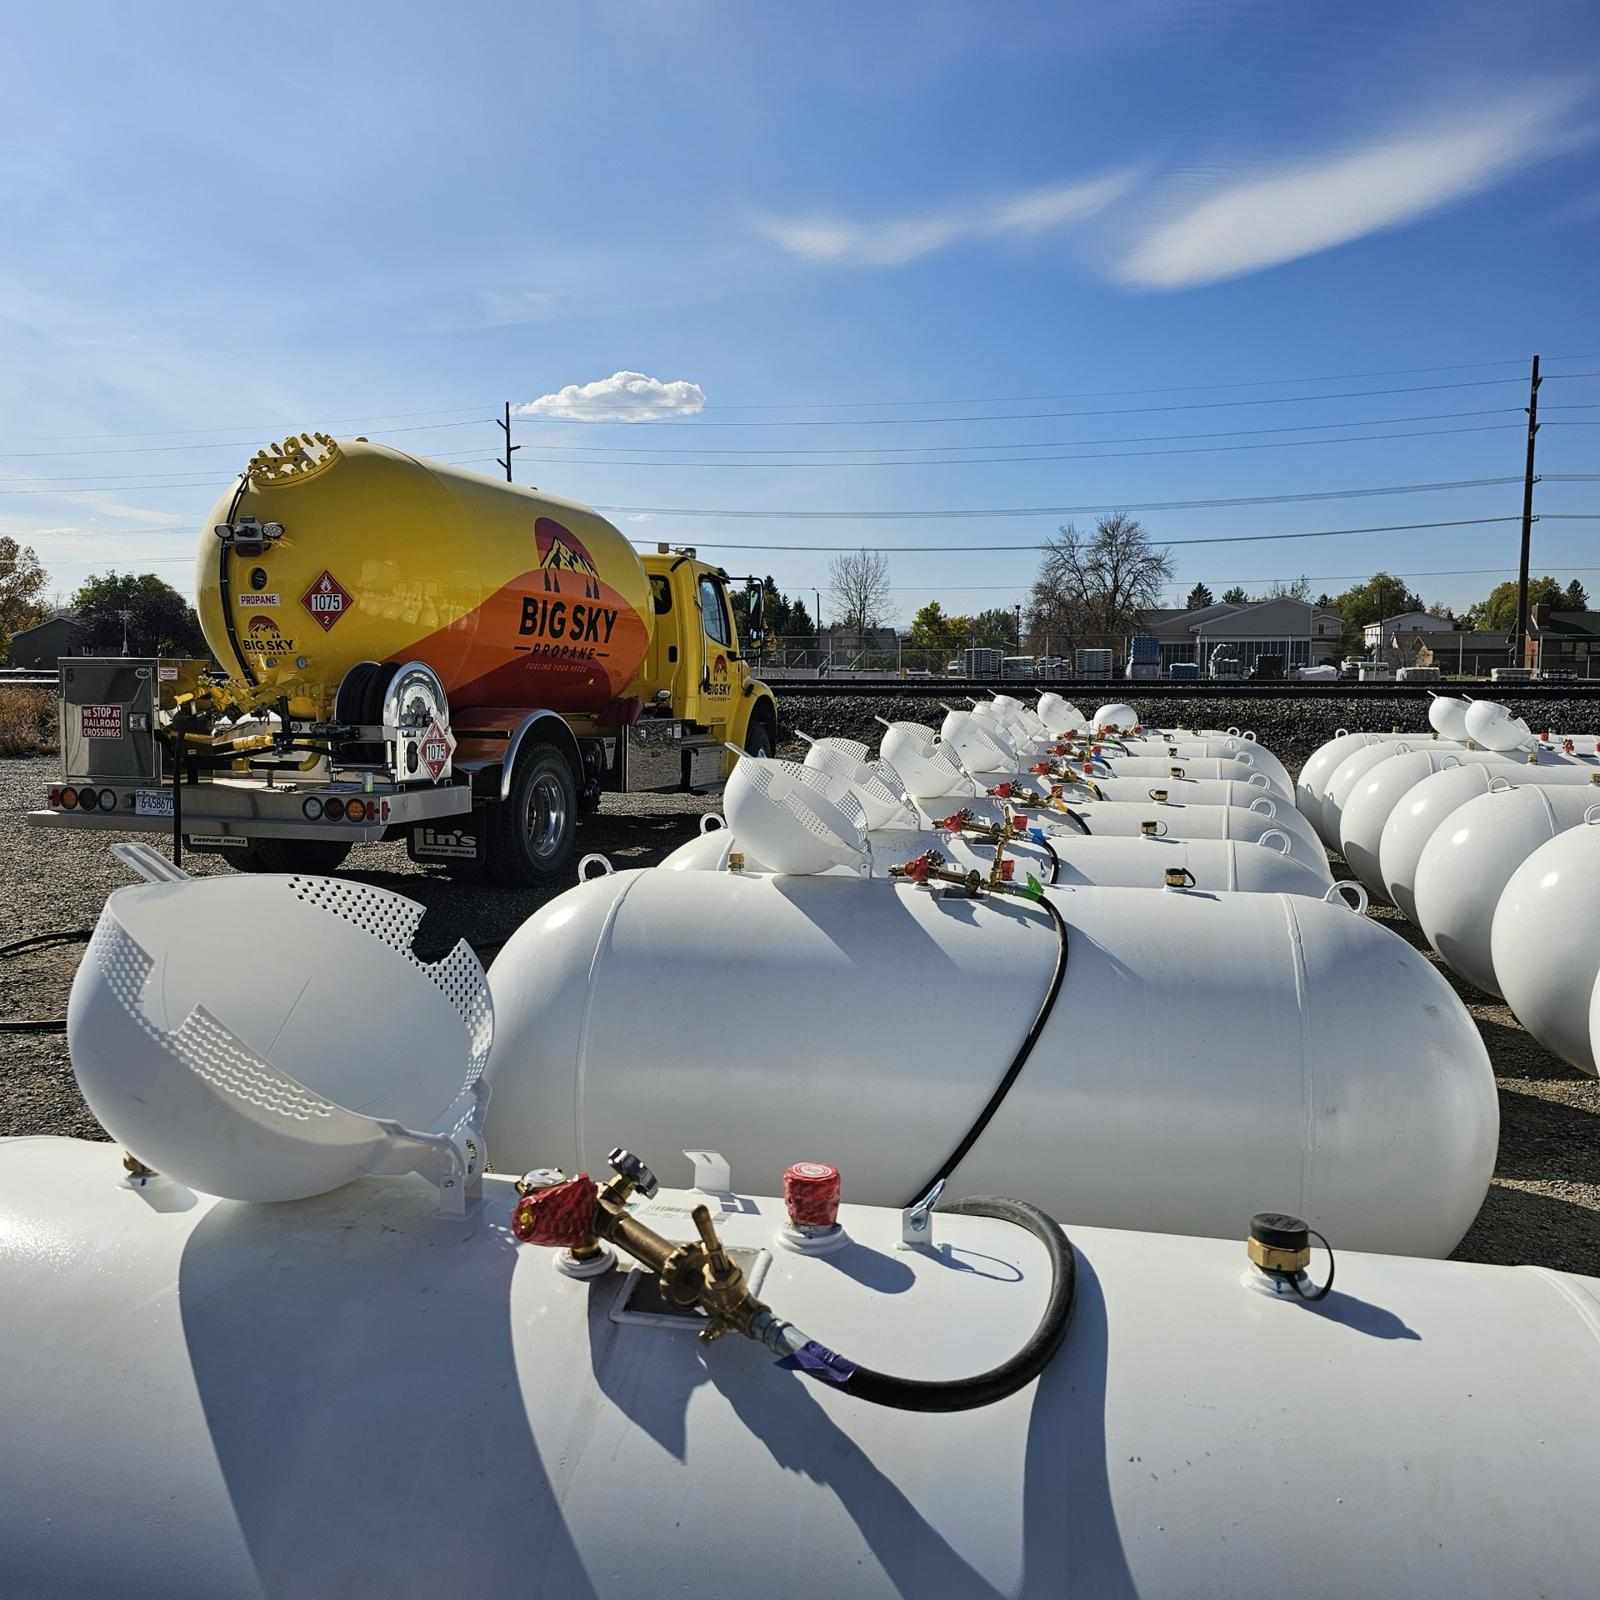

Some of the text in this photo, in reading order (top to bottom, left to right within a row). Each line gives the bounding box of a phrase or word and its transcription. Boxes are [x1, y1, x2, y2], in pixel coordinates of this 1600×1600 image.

[240, 595, 276, 604] PROPANE
[313, 595, 340, 610] 1075
[323, 616, 330, 624] 2
[519, 597, 618, 643] BIG SKY
[243, 640, 294, 650] BIG SKY
[531, 643, 596, 659] PROPANE
[719, 684, 731, 696] SKY
[83, 708, 120, 718] WE STOP AT
[84, 718, 120, 727] RAILROAD
[84, 728, 120, 736] CROSSINGS
[427, 744, 445, 760] 1075
[434, 764, 438, 772] 2
[414, 828, 476, 849] Lin's
